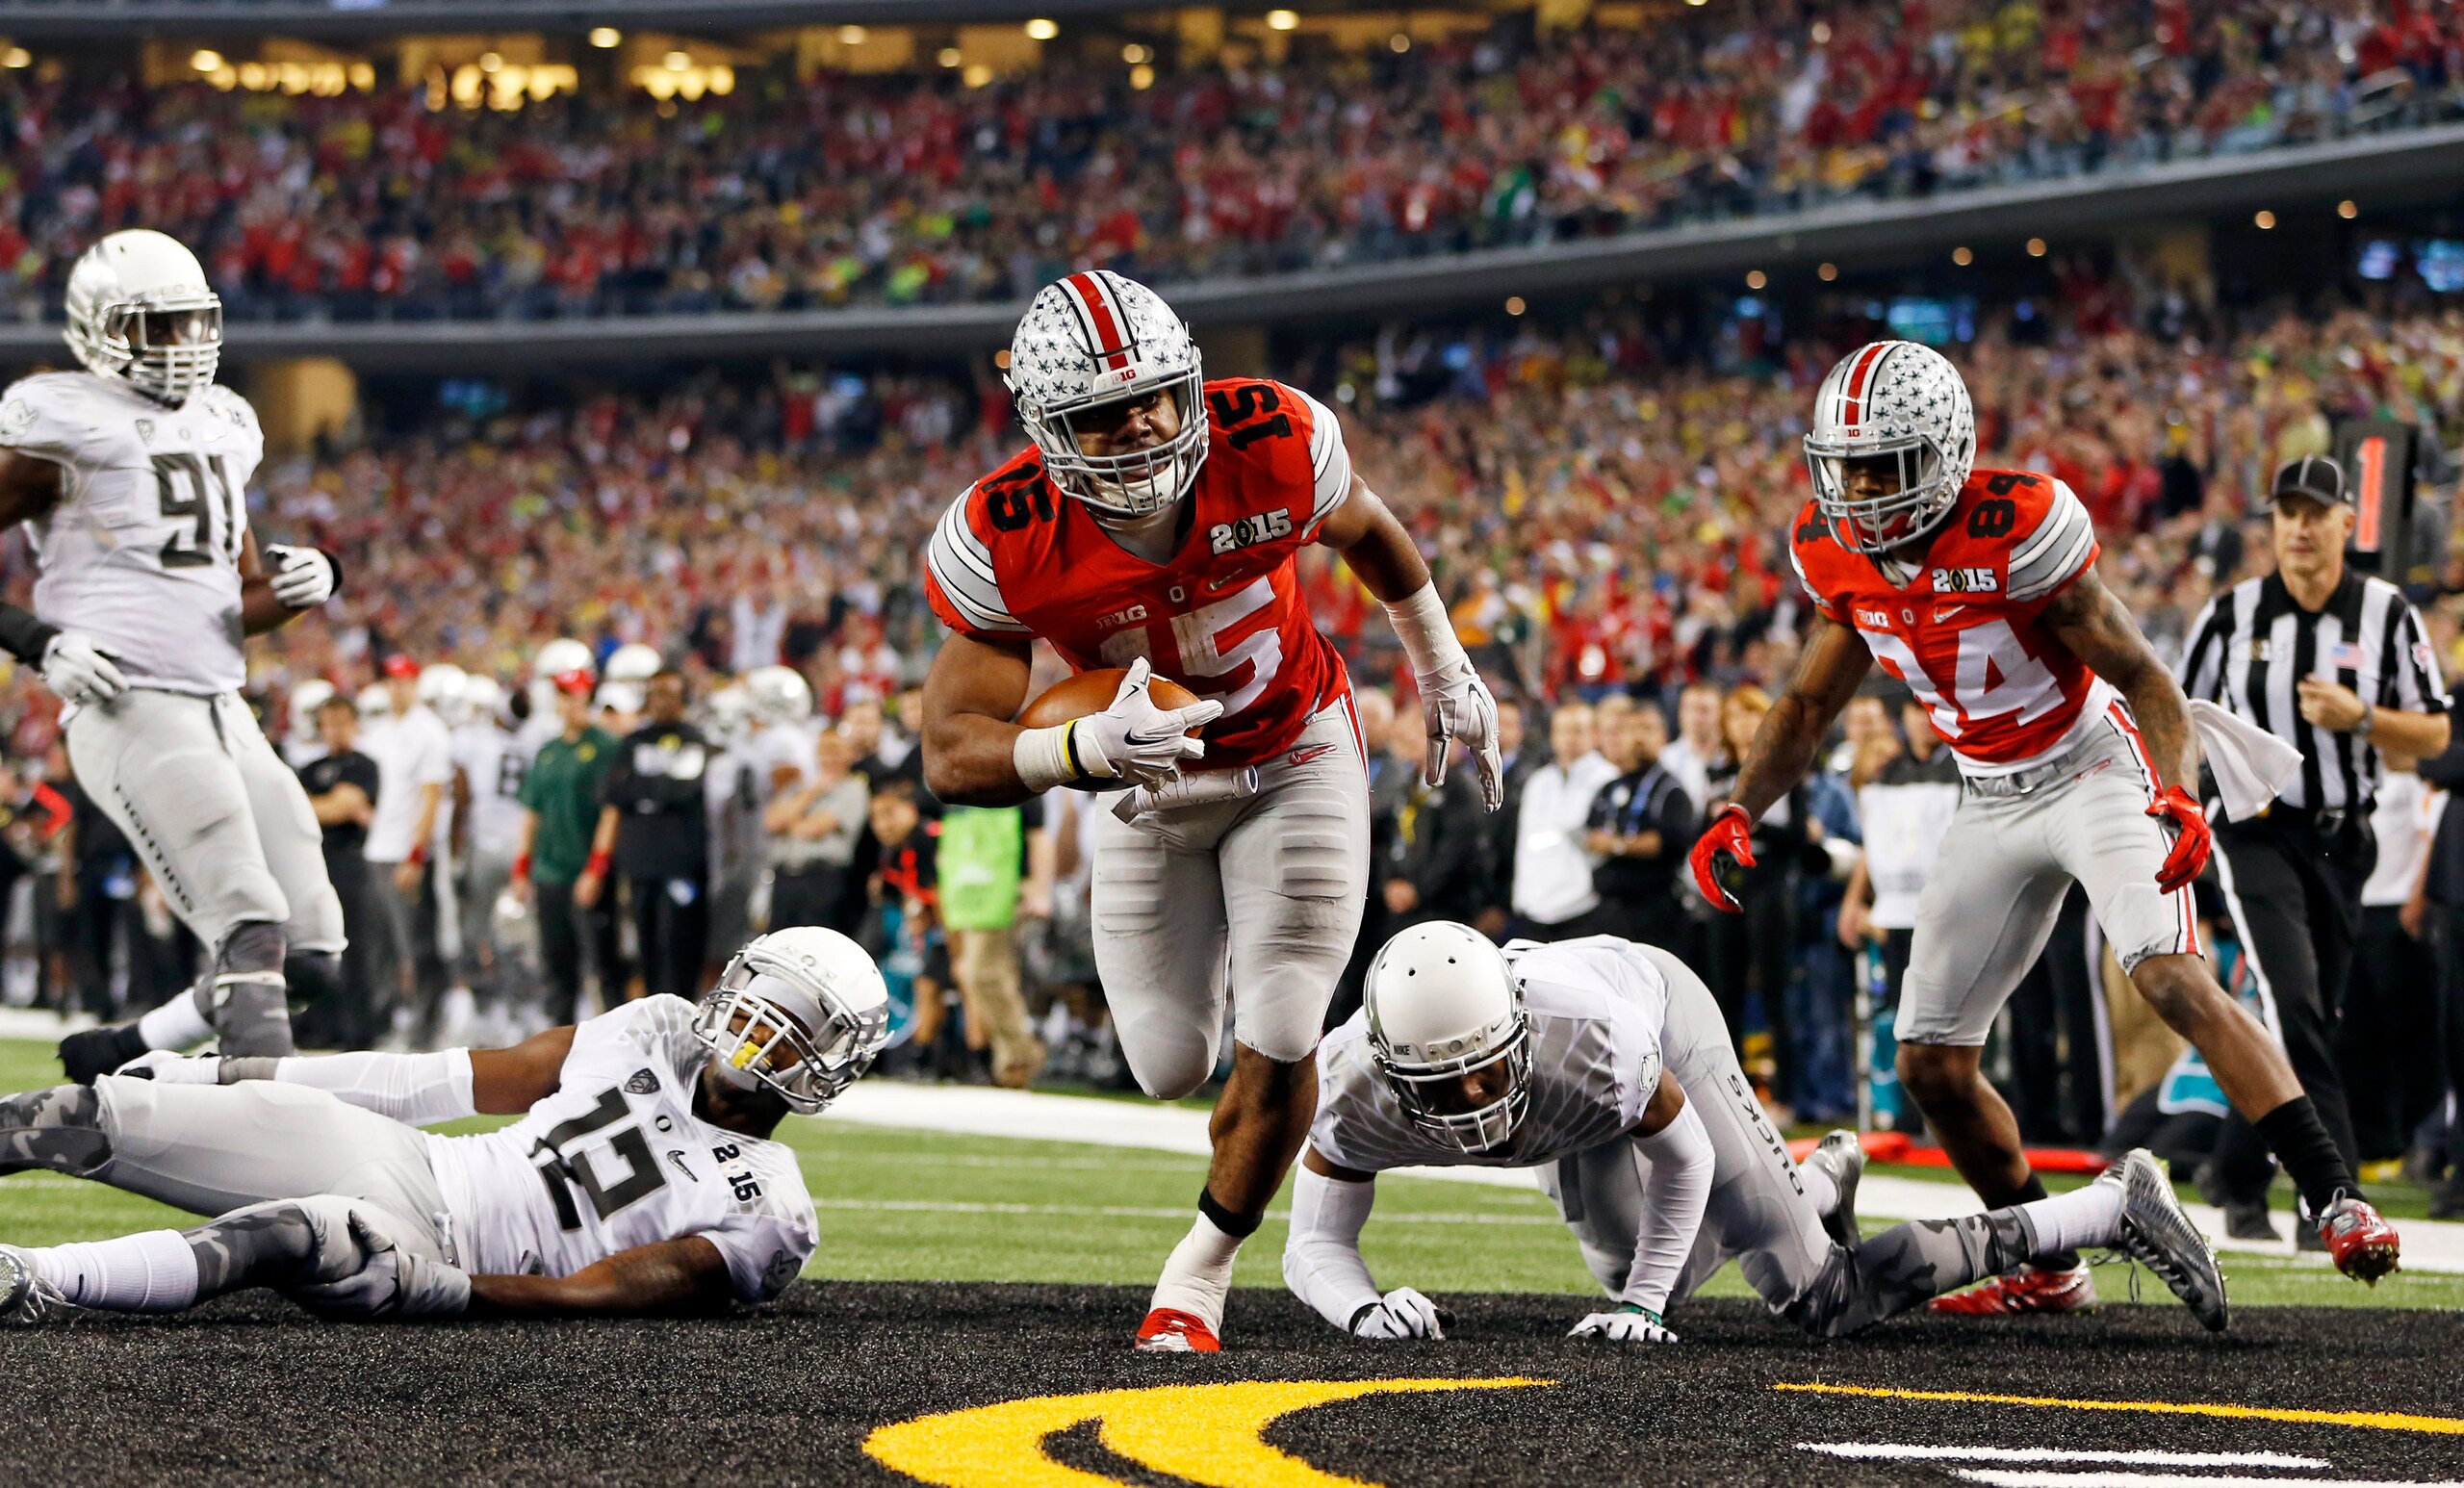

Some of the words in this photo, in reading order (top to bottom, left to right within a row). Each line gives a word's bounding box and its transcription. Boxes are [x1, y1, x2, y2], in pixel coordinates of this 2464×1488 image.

[1211, 384, 1293, 450] 15
[150, 452, 234, 568] 91
[981, 463, 1056, 532] 15
[1967, 473, 2039, 539] 84
[2355, 436, 2386, 552] 1
[1210, 507, 1292, 554] 2015
[1932, 568, 1997, 593] 2015
[1394, 1045, 1410, 1056] NIKE
[529, 1085, 667, 1231] 12
[1727, 1074, 1804, 1196] DUCKS
